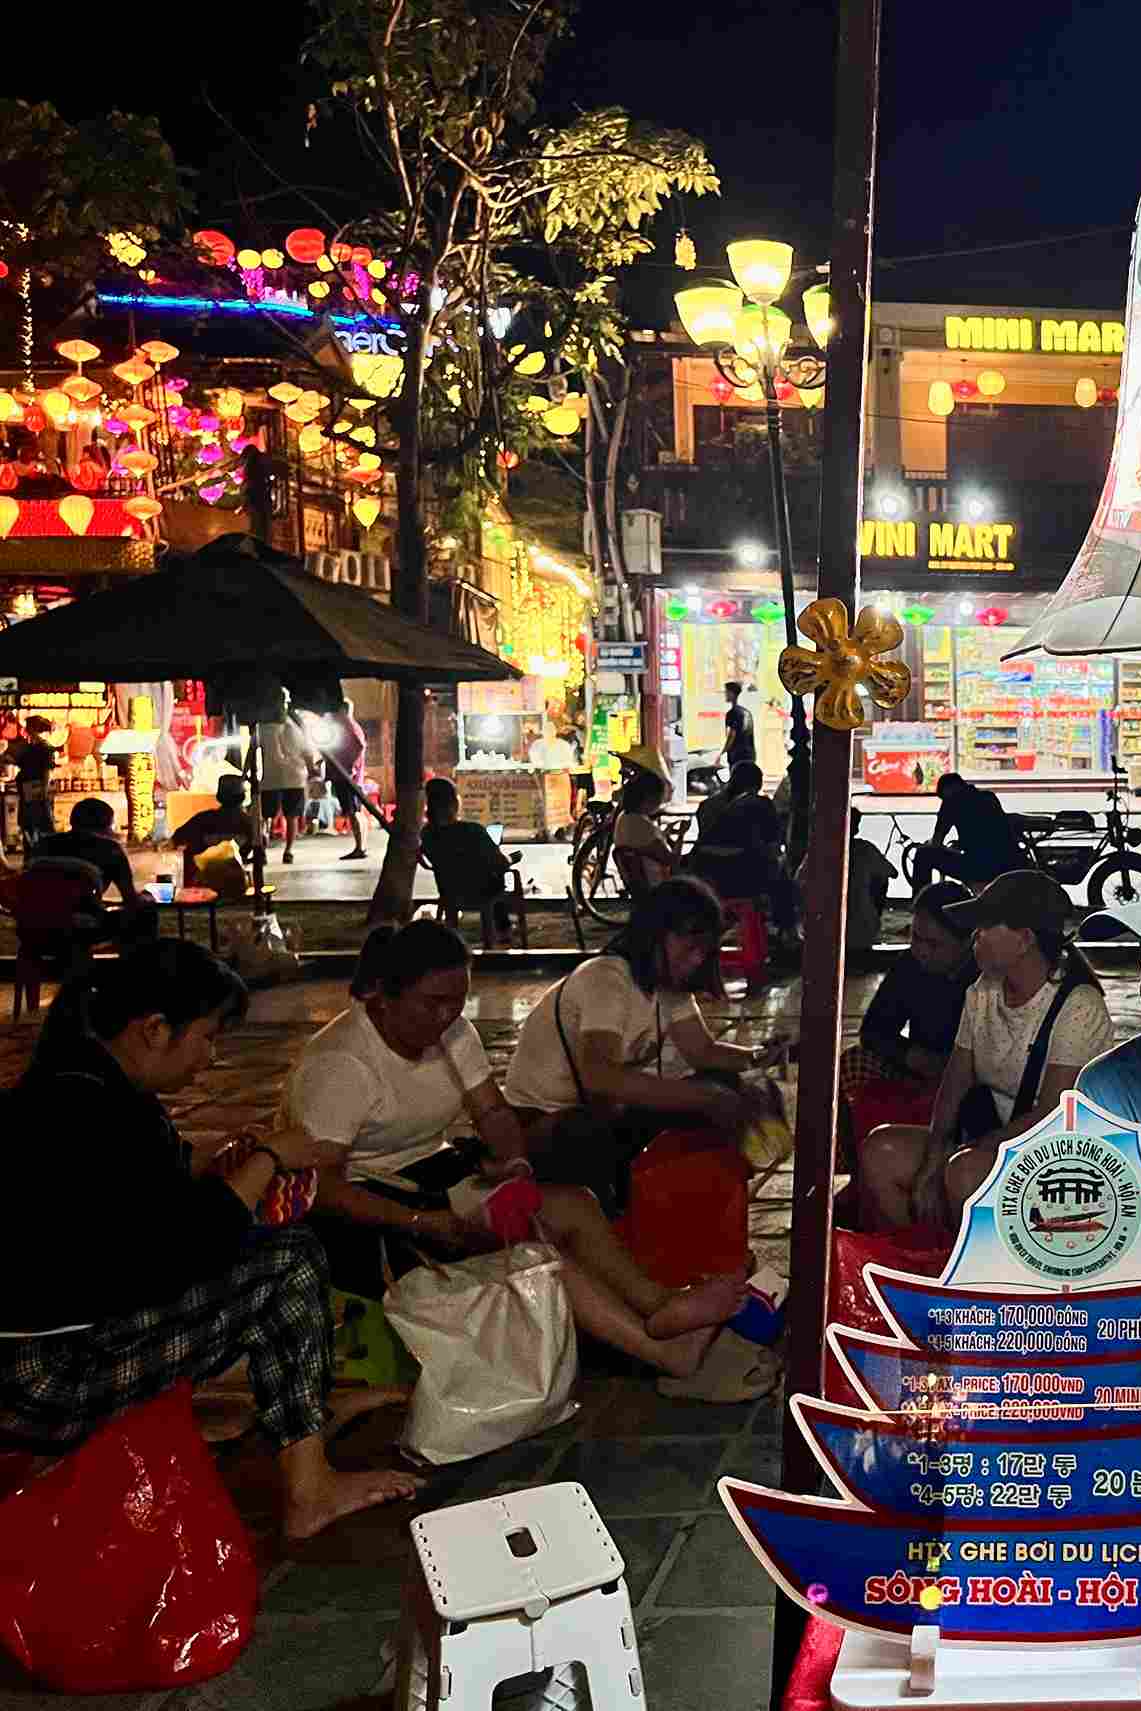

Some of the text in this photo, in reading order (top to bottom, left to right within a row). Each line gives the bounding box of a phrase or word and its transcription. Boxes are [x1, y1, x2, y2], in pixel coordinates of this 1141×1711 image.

[945, 316, 1126, 353] MINI MAR
[929, 522, 1014, 558] MART
[1035, 1146, 1050, 1163] DU
[1006, 1170, 1025, 1193] GHE
[1002, 1195, 1018, 1216] HTX
[1120, 1204, 1137, 1218] AN
[998, 1306, 1053, 1328] 170,000
[1097, 1319, 1115, 1341] 20
[996, 1331, 1054, 1354] 220,000
[961, 1376, 1000, 1393] PRICE:
[1001, 1373, 1084, 1395] 170,000VND
[1094, 1387, 1111, 1408] 20
[997, 1453, 1046, 1477] 17만
[1052, 1454, 1077, 1478] 동
[1093, 1470, 1126, 1496] 20
[991, 1484, 1040, 1507] 22만
[1048, 1484, 1072, 1508] 동
[908, 1542, 951, 1561] HTX
[960, 1542, 1007, 1562] GHE
[1015, 1540, 1054, 1562] BƠI
[1062, 1543, 1093, 1562] DU
[967, 1571, 1053, 1605] HOÀI
[1076, 1572, 1140, 1612] HỘI
